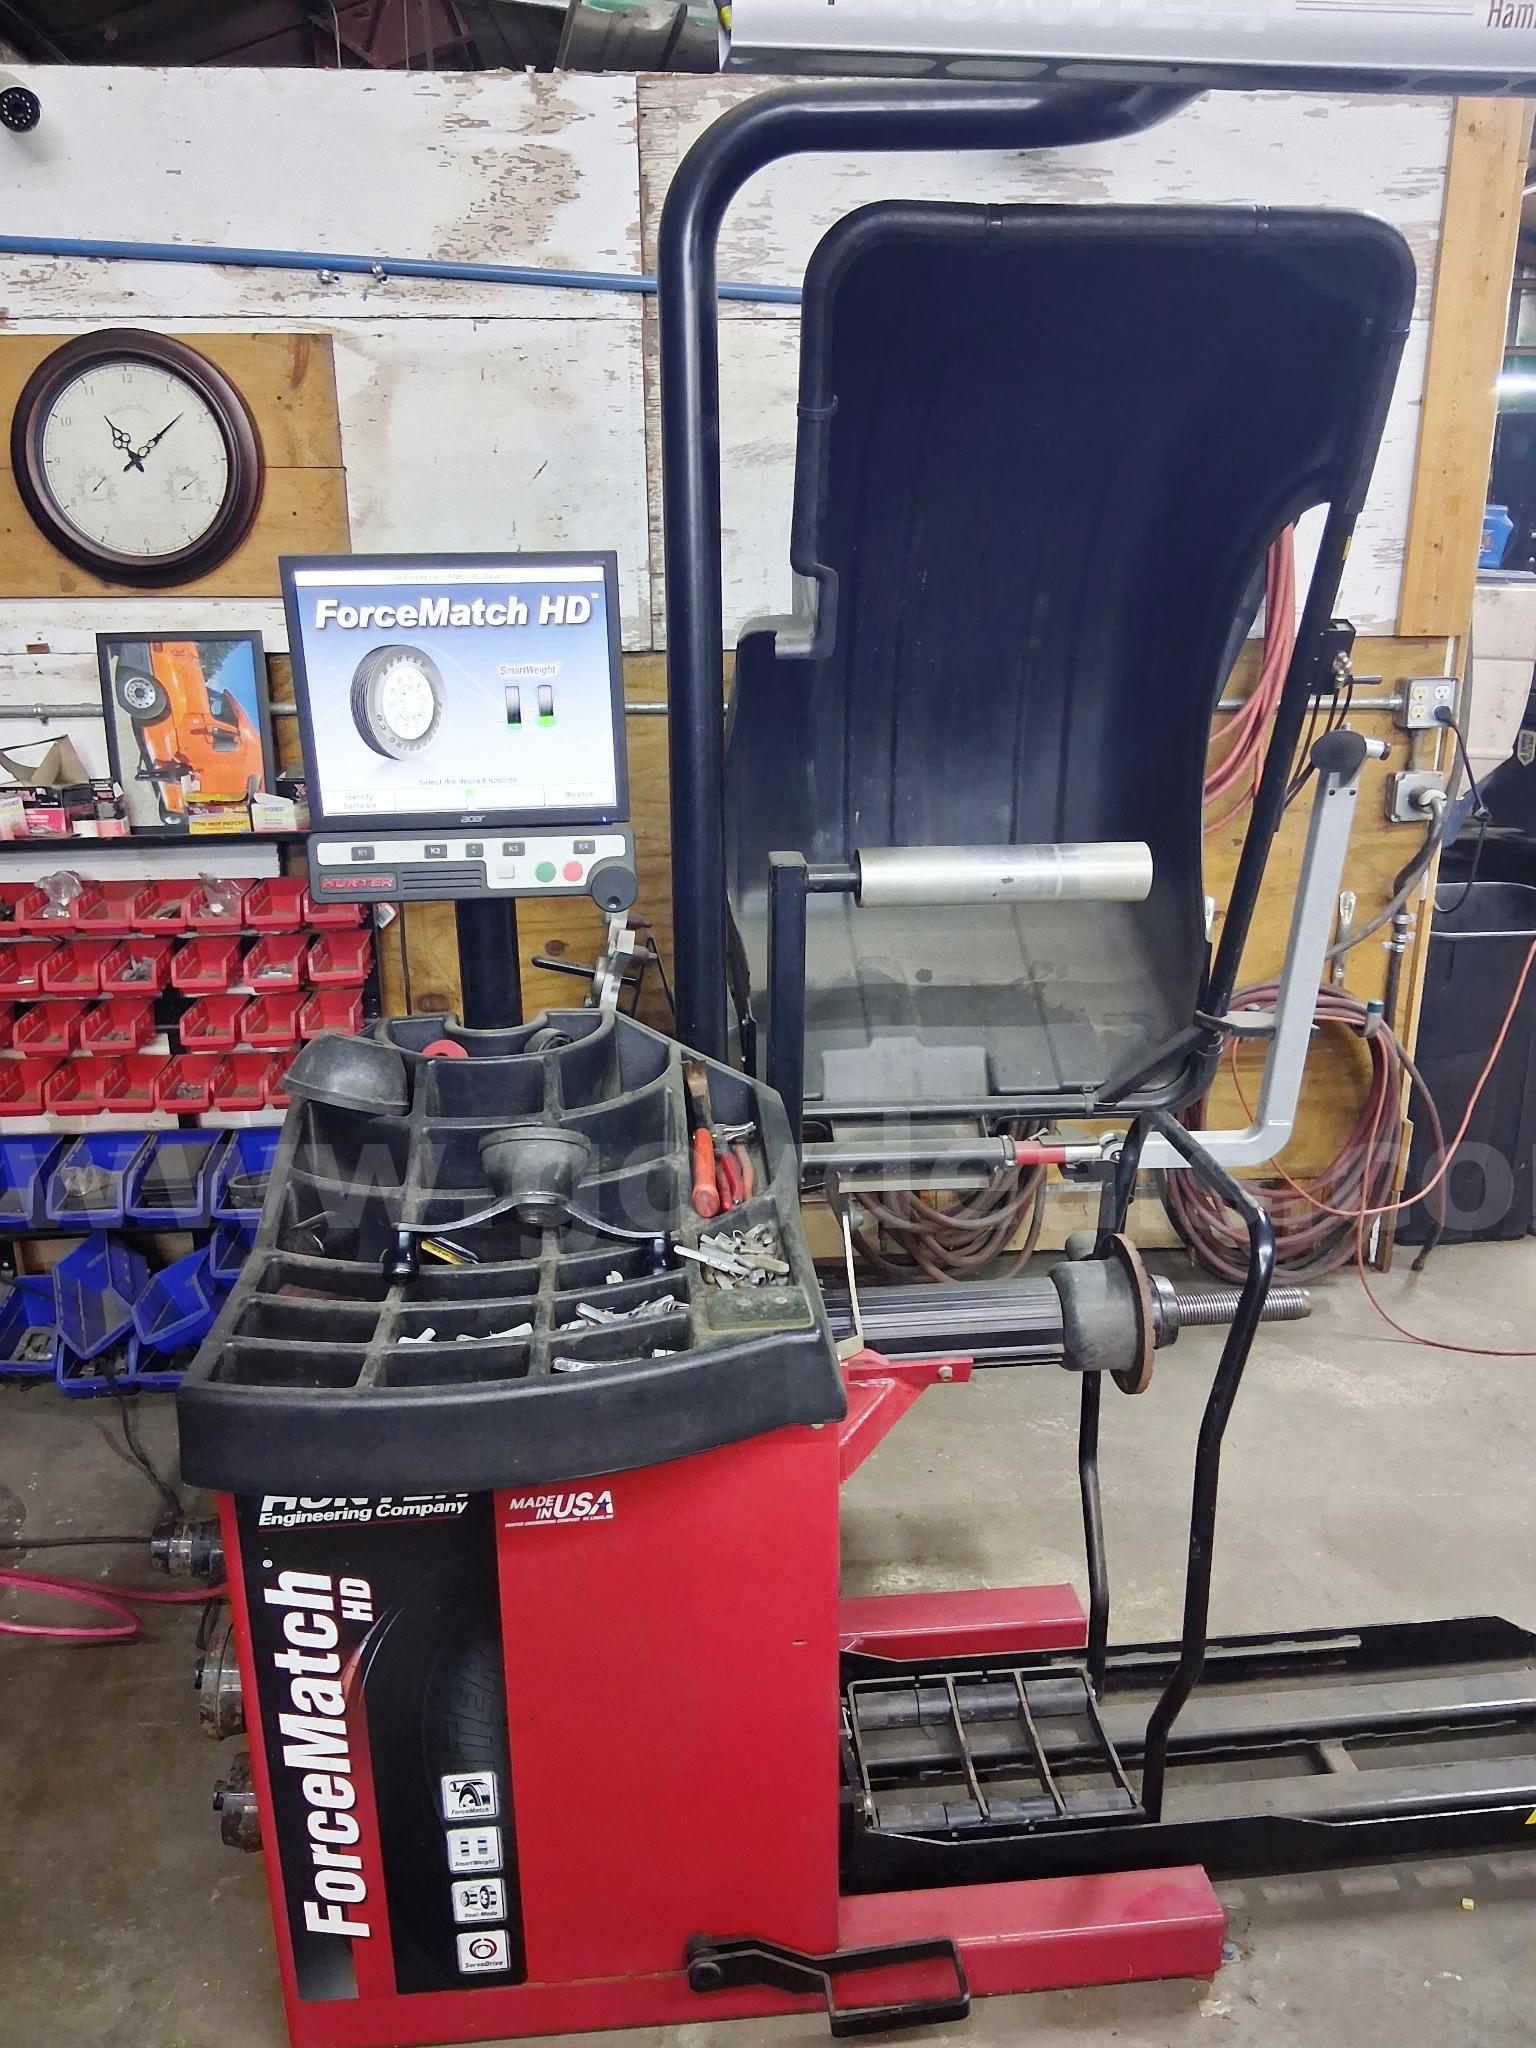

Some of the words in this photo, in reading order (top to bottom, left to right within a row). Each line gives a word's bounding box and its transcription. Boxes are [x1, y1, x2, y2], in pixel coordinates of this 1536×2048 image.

[1487, 0, 1536, 29] Ham
[121, 373, 134, 384] 12
[84, 386, 95, 396] 11
[60, 417, 72, 427] 10
[54, 455, 61, 466] 9
[103, 525, 110, 536] 7
[143, 536, 150, 546] 6
[314, 595, 529, 629] ForceMatch
[539, 594, 592, 625] HD
[500, 665, 556, 676] SmartWeight
[460, 815, 486, 823] acer
[430, 847, 441, 855] K2
[321, 877, 394, 889] HUNTER
[509, 1495, 556, 1510] MADE
[535, 1507, 553, 1520] IN
[553, 1490, 614, 1518] USA
[258, 1507, 372, 1527] Engineering
[375, 1500, 469, 1517] Company
[339, 1577, 374, 1622] HD
[264, 1570, 371, 1938] ForceMatch
[451, 1807, 489, 1815] ForceMatch
[454, 1858, 496, 1867] SmartWeight
[465, 1960, 504, 1968] ServoDrive
